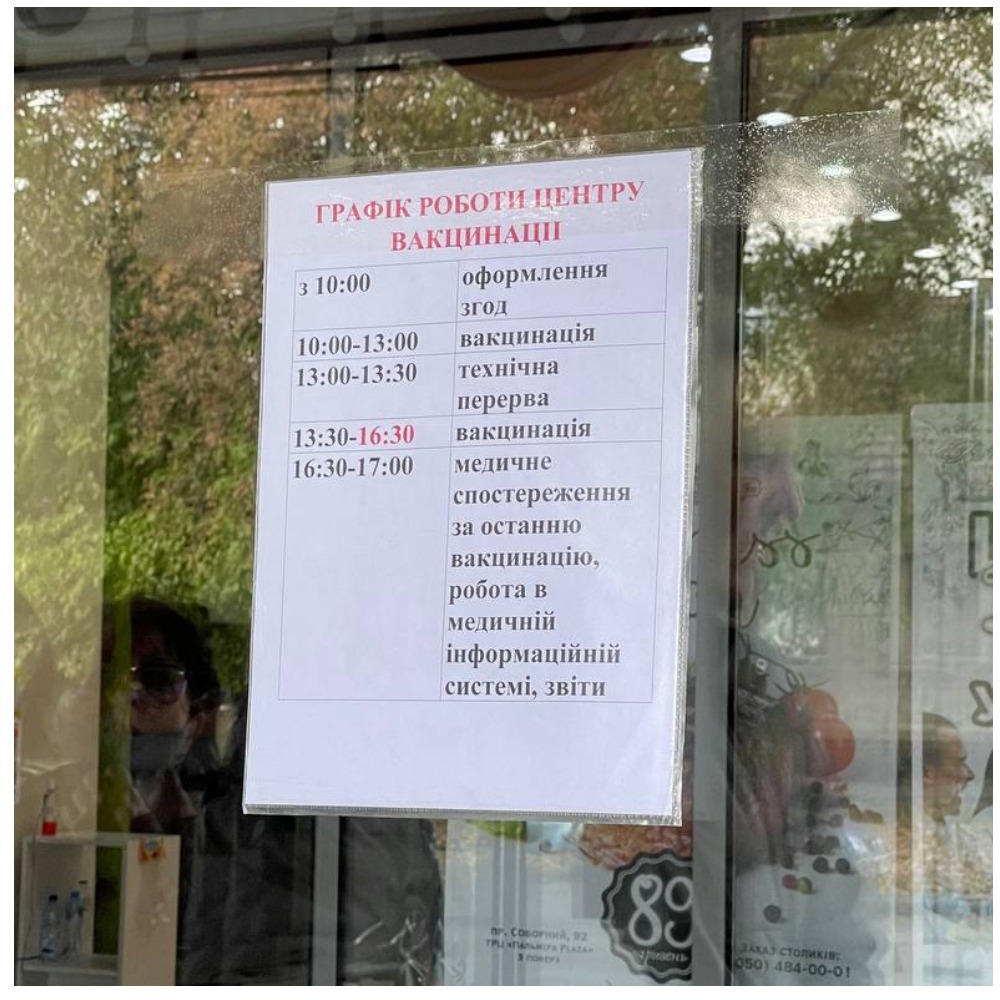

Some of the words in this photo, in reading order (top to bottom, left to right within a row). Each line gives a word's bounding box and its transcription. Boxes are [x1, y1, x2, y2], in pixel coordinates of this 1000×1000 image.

[315, 198, 410, 224] ГРАФІК
[419, 189, 526, 217] РОБОТИ
[534, 181, 646, 211] ЦЕНТРУ
[316, 273, 371, 296] 10:00
[462, 264, 609, 290] оформлення
[460, 299, 508, 318] згод
[298, 331, 419, 357] 10:00-13:00
[460, 325, 596, 351] вакцинація
[297, 362, 418, 388] 13:00-13:30
[458, 357, 560, 380] технічна
[457, 392, 550, 415] перерва
[294, 424, 415, 449] 13:30-16:30
[455, 419, 592, 443] вакцинація
[293, 455, 414, 479] 16:30-17:00
[454, 455, 552, 475] медичне
[453, 485, 631, 508] спостереження
[451, 520, 474, 537] за
[480, 517, 582, 536] останню
[450, 547, 600, 570] вакцинацію,
[449, 580, 527, 606] робота
[534, 583, 548, 598] в
[448, 611, 556, 633] медичній
[446, 644, 621, 668] інформаційній
[445, 678, 538, 700] системі,
[544, 678, 606, 697] звіти
[628, 874, 693, 949] 89
[735, 957, 769, 974] 050)
[775, 960, 851, 979] 484-00-01
